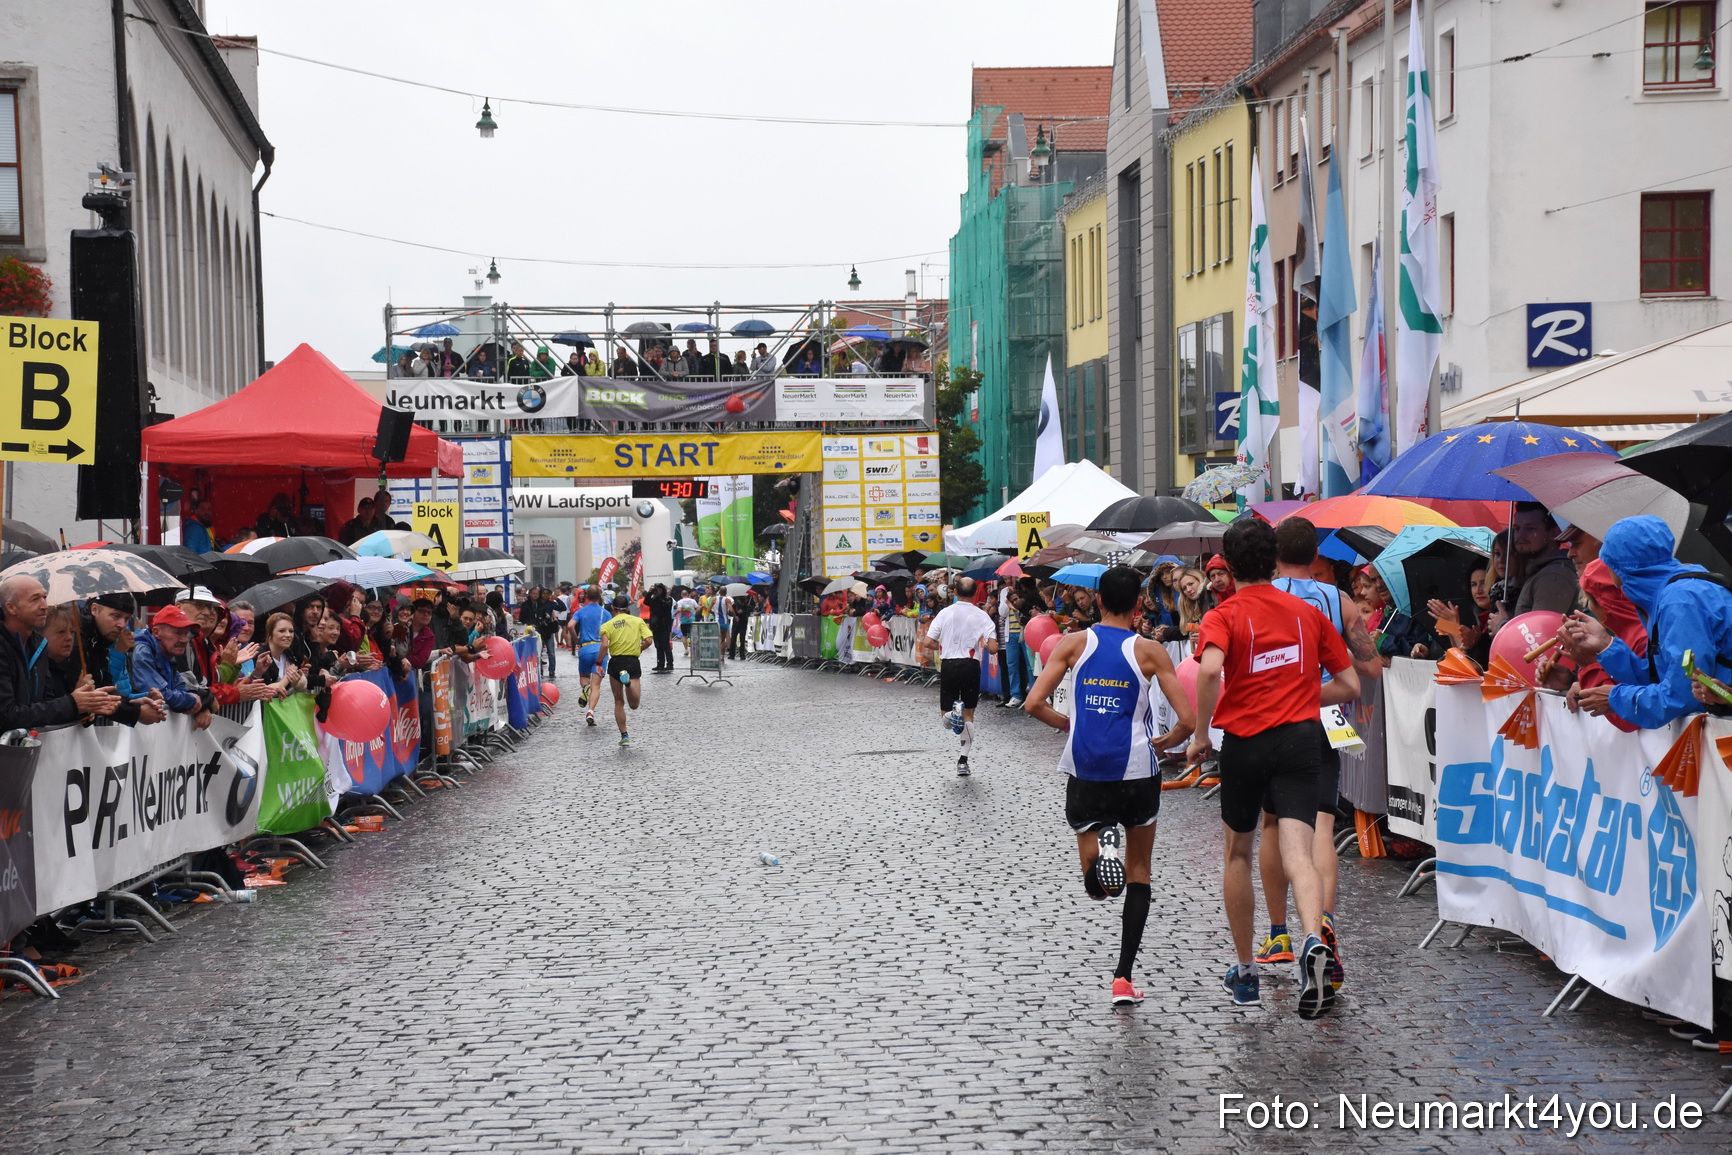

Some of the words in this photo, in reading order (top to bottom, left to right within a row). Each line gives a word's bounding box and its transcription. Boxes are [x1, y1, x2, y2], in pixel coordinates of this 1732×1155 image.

[9, 322, 88, 352] Block
[21, 361, 72, 431] B
[586, 389, 645, 404] BOCK
[614, 442, 720, 468] START
[865, 466, 889, 474] swn
[660, 481, 704, 497] 43:01
[547, 494, 631, 511] Laufsport
[418, 505, 454, 518] Block
[1020, 514, 1047, 524] Block
[421, 523, 449, 556] A
[1025, 527, 1044, 552] A
[1265, 653, 1286, 665] DEHN
[1083, 678, 1098, 686] LAC
[1099, 679, 1130, 688] QUELLE
[1085, 694, 1121, 708] HEITEC
